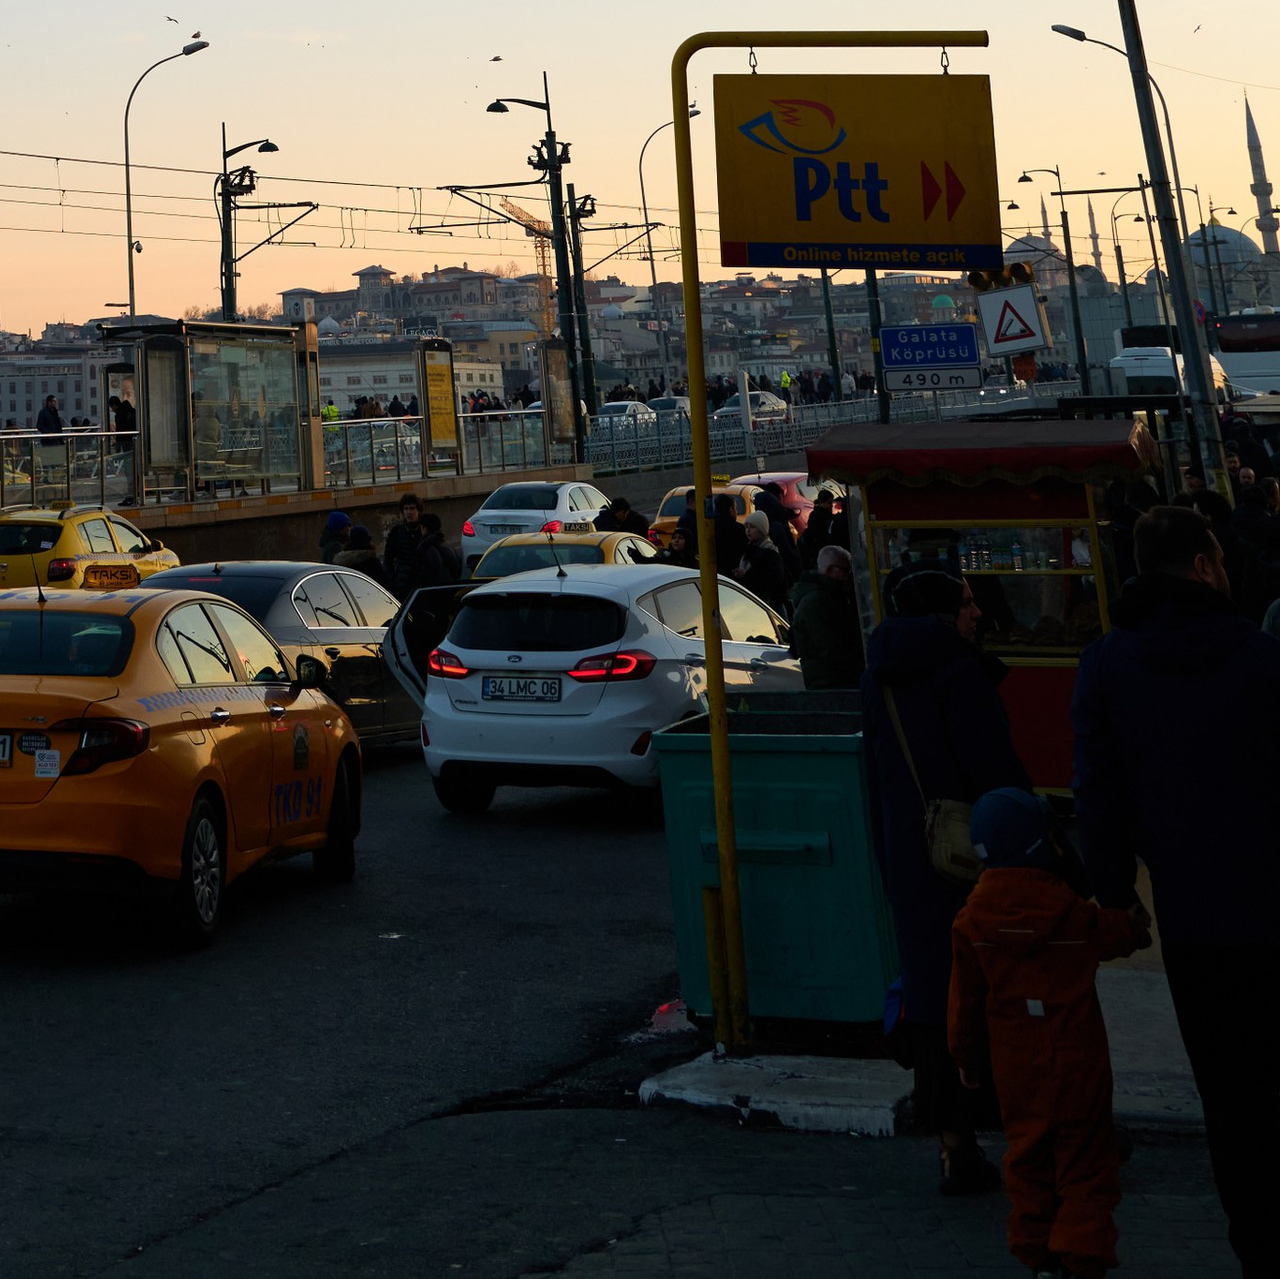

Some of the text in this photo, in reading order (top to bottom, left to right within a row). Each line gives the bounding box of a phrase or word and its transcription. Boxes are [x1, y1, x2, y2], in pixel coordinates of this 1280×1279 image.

[794, 156, 890, 223] Ptt
[783, 246, 966, 267] Online hizmete açık
[898, 330, 958, 343] Galata
[891, 345, 969, 362] Köprüsü
[903, 373, 964, 386] 490 m
[490, 680, 557, 695] 34 LMC 06
[276, 775, 322, 826] TKD 91
